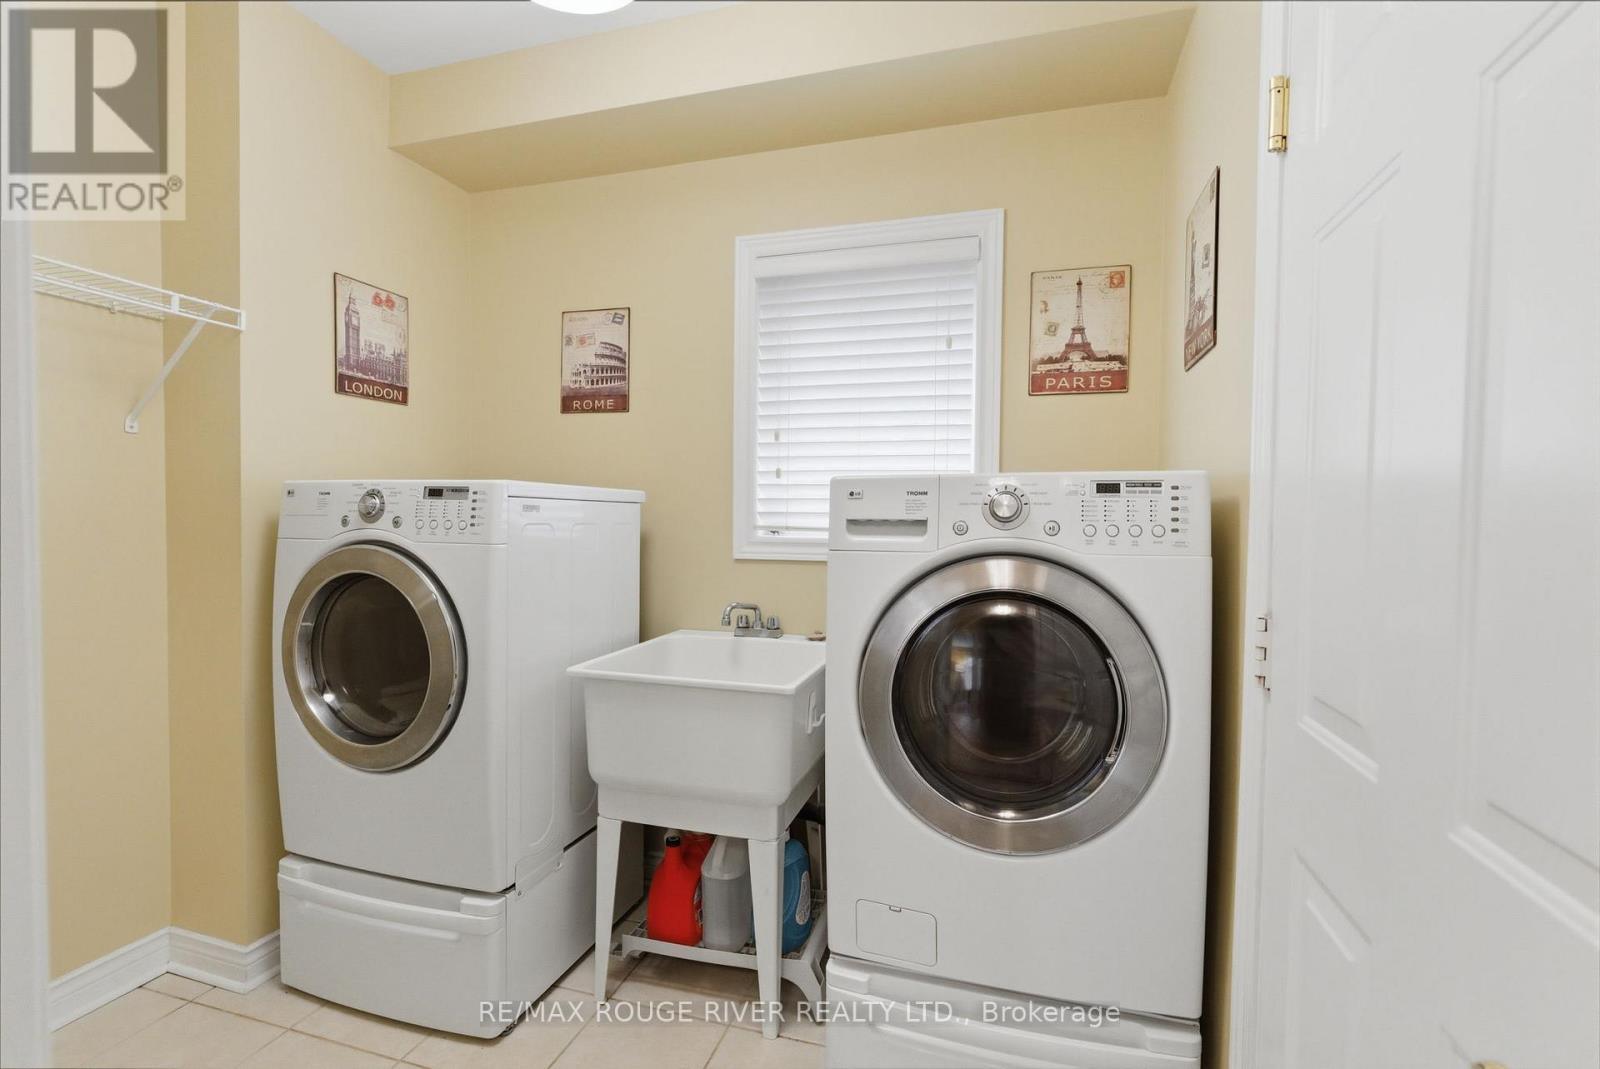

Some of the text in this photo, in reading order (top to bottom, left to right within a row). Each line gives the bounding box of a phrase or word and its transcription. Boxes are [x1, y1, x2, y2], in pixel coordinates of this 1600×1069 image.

[1045, 375, 1112, 390] PARIS
[344, 380, 403, 401] LONDON
[573, 399, 615, 410] ROME
